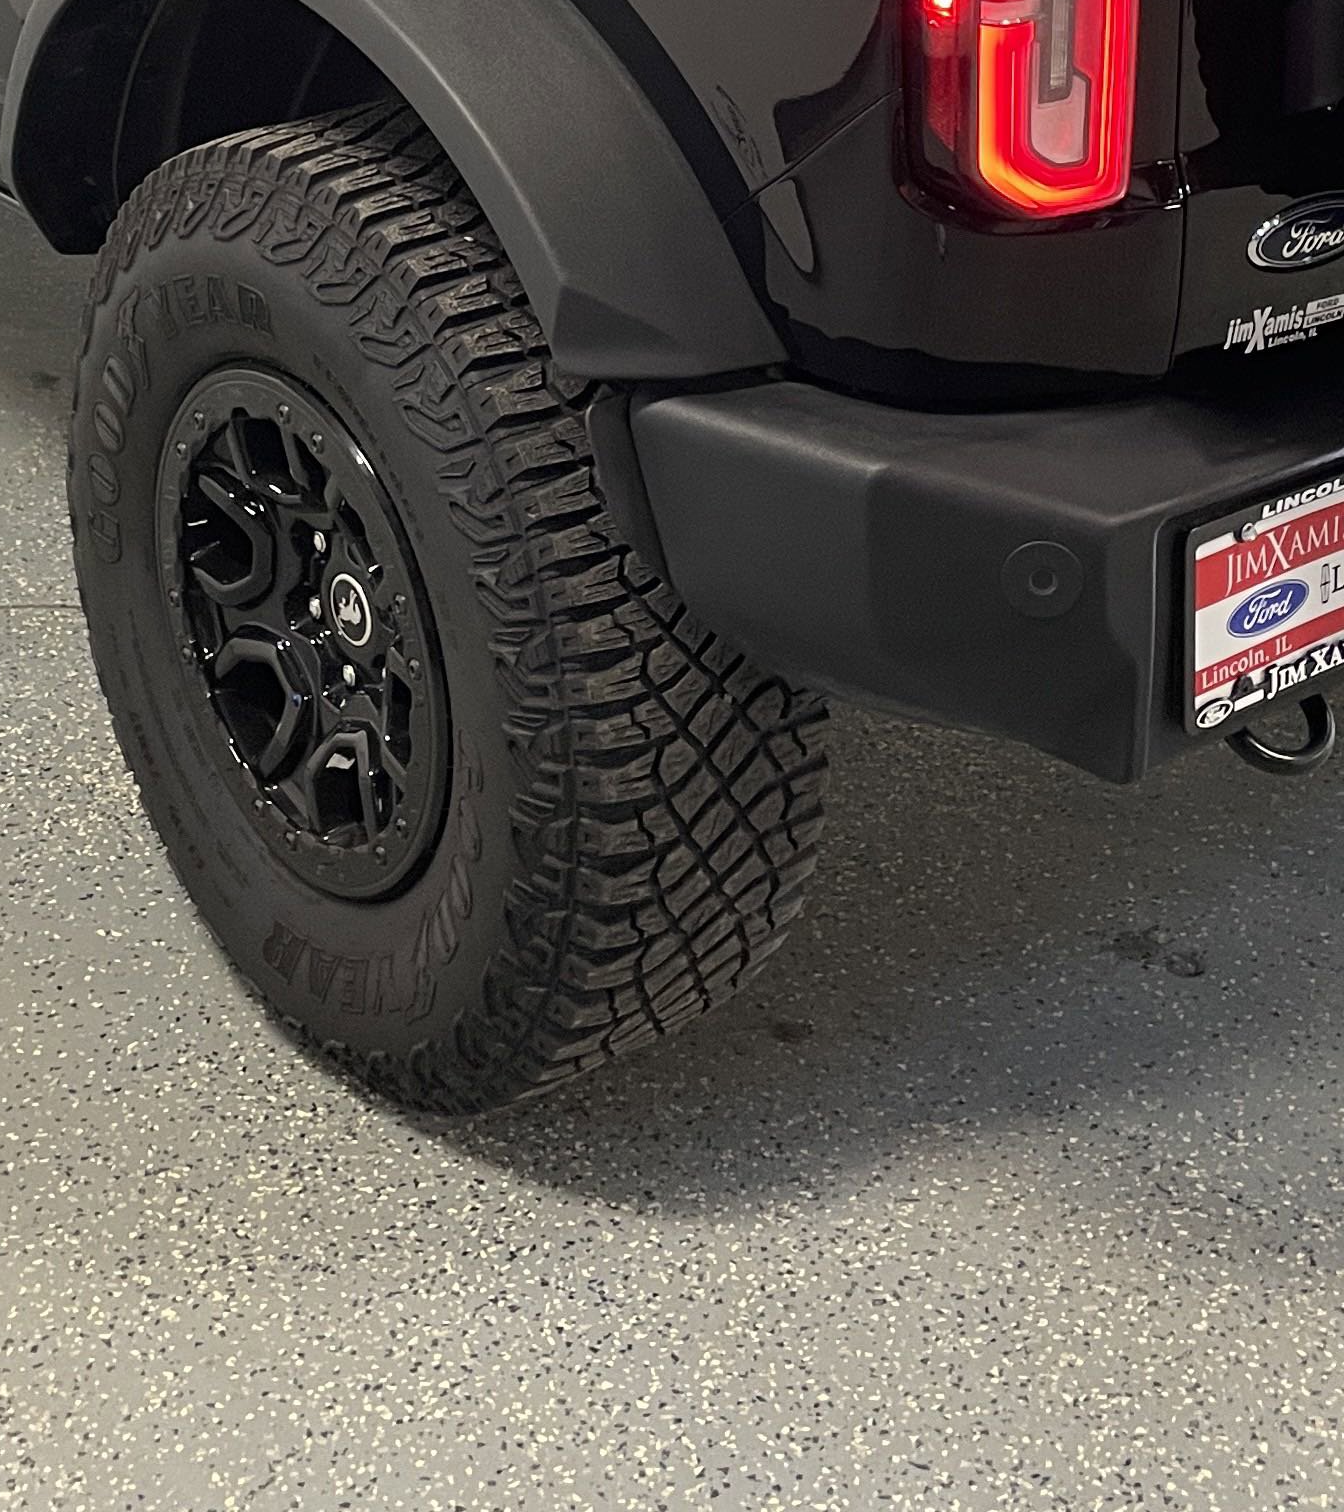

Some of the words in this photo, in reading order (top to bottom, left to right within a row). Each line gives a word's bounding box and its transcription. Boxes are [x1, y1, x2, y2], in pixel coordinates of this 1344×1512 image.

[1316, 297, 1340, 310] FORD
[1305, 309, 1344, 326] LINCOLN
[1243, 590, 1294, 631] Ford
[1275, 636, 1293, 657] IL
[1267, 663, 1307, 699] JIM
